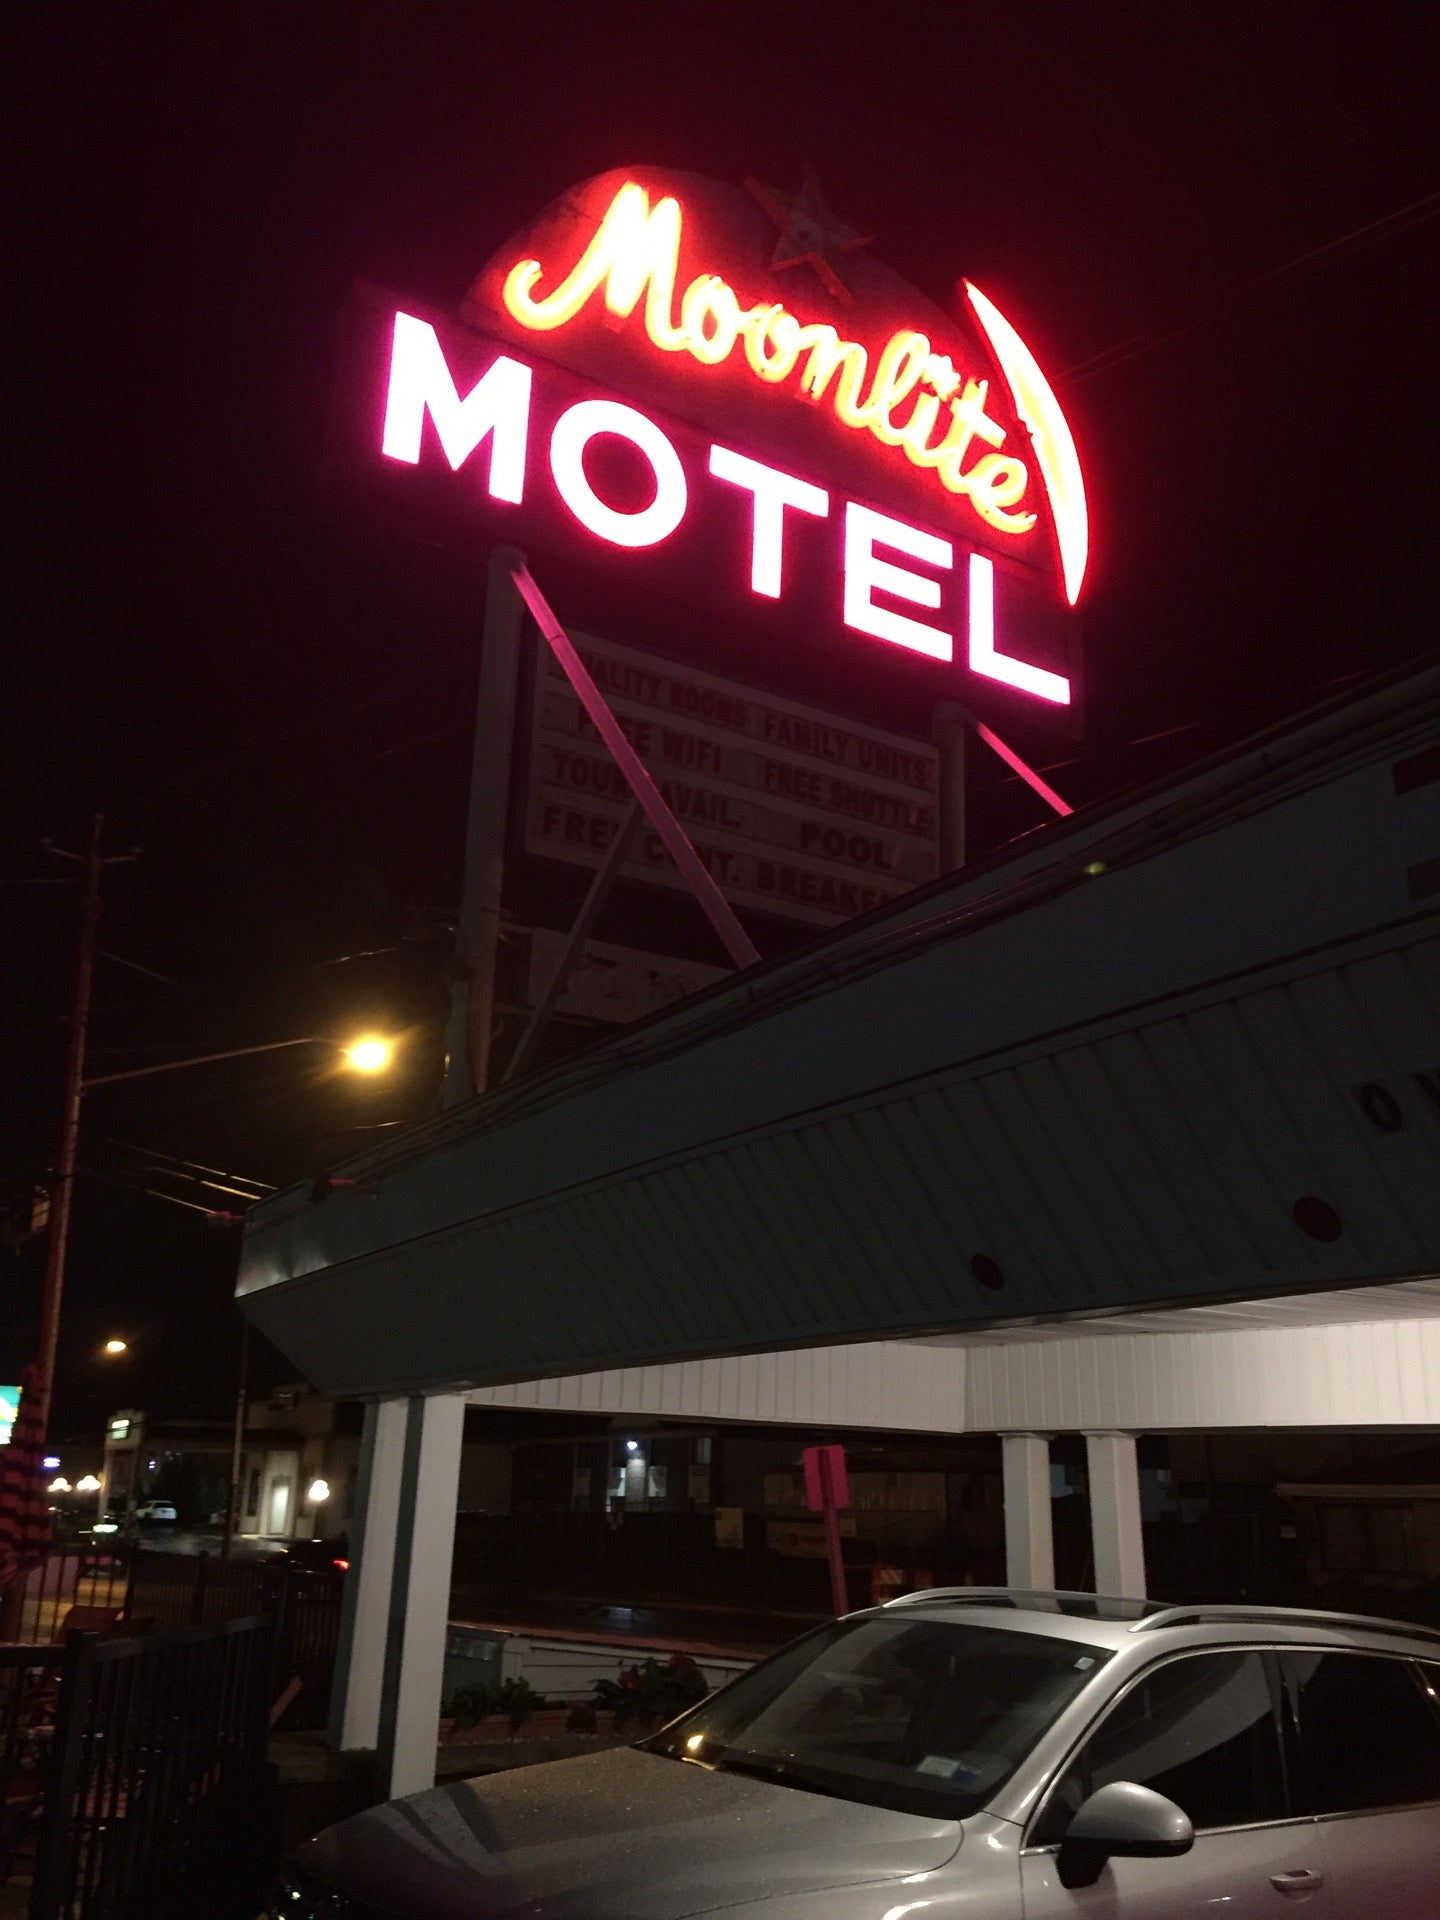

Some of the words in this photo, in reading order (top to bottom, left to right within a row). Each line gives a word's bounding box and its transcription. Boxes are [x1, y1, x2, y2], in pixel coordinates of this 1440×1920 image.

[503, 180, 1038, 534] Moonlite
[381, 311, 1071, 705] MOTEL
[577, 703, 650, 753] FEE
[662, 728, 722, 773] WIFI
[765, 761, 821, 801] FREE
[830, 781, 929, 832] SHUTTLE
[670, 681, 746, 727] ROOMS
[765, 712, 850, 762] FAMILY
[857, 741, 928, 785] UNITS
[543, 805, 620, 848] FRE
[644, 834, 739, 882] CNT.
[800, 821, 892, 870] POOL
